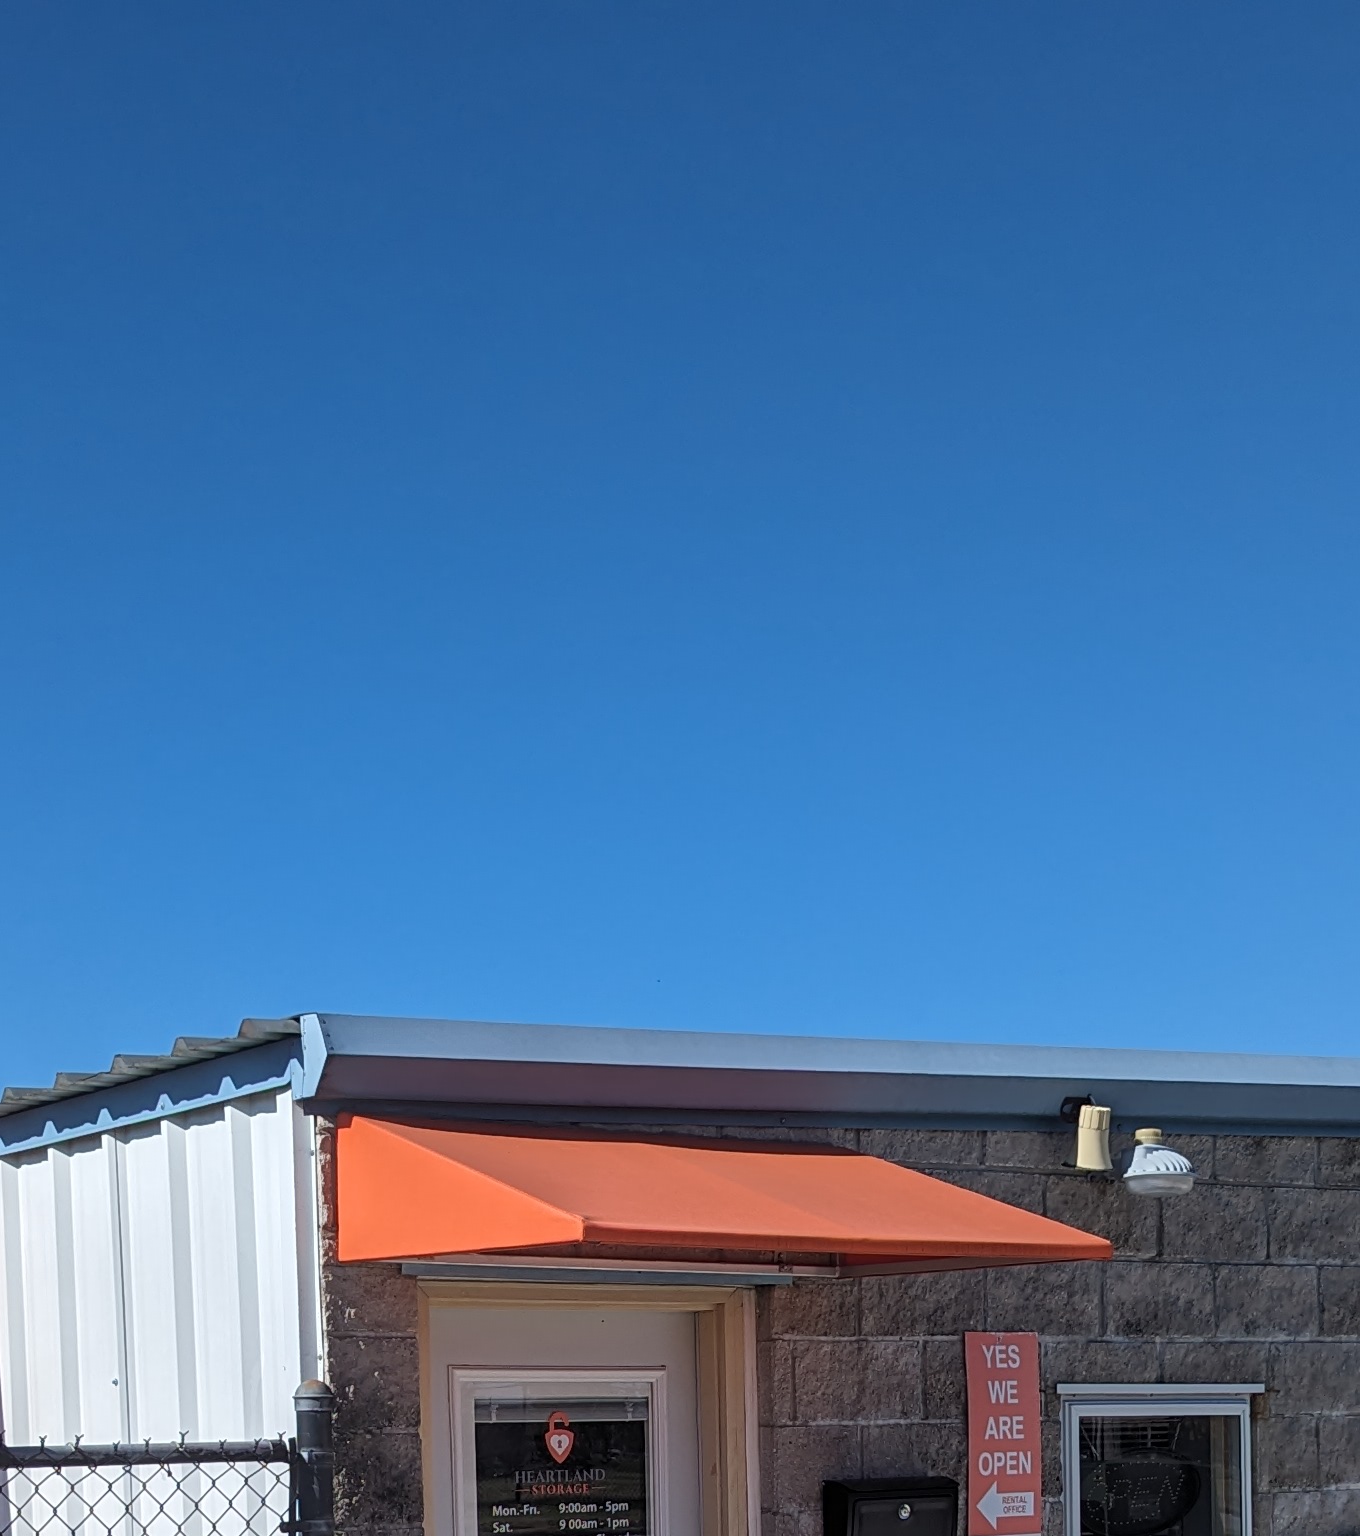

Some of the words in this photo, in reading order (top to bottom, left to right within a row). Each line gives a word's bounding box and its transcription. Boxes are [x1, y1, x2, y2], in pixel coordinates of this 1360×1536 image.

[981, 1344, 1020, 1369] YES
[987, 1380, 1020, 1404] WE
[984, 1416, 1025, 1440] ARE
[978, 1451, 1032, 1476] OPEN
[514, 1468, 607, 1485] HEARTLAND
[530, 1483, 590, 1496] STORAGE
[1001, 1495, 1028, 1505] RENTAL
[492, 1504, 541, 1517] Mon.-Fri.
[558, 1502, 597, 1515] 9:00am
[605, 1501, 629, 1515] 5pm
[1002, 1504, 1027, 1514] OFFICE
[492, 1521, 514, 1534] Sat.
[606, 1517, 630, 1530] 1pm
